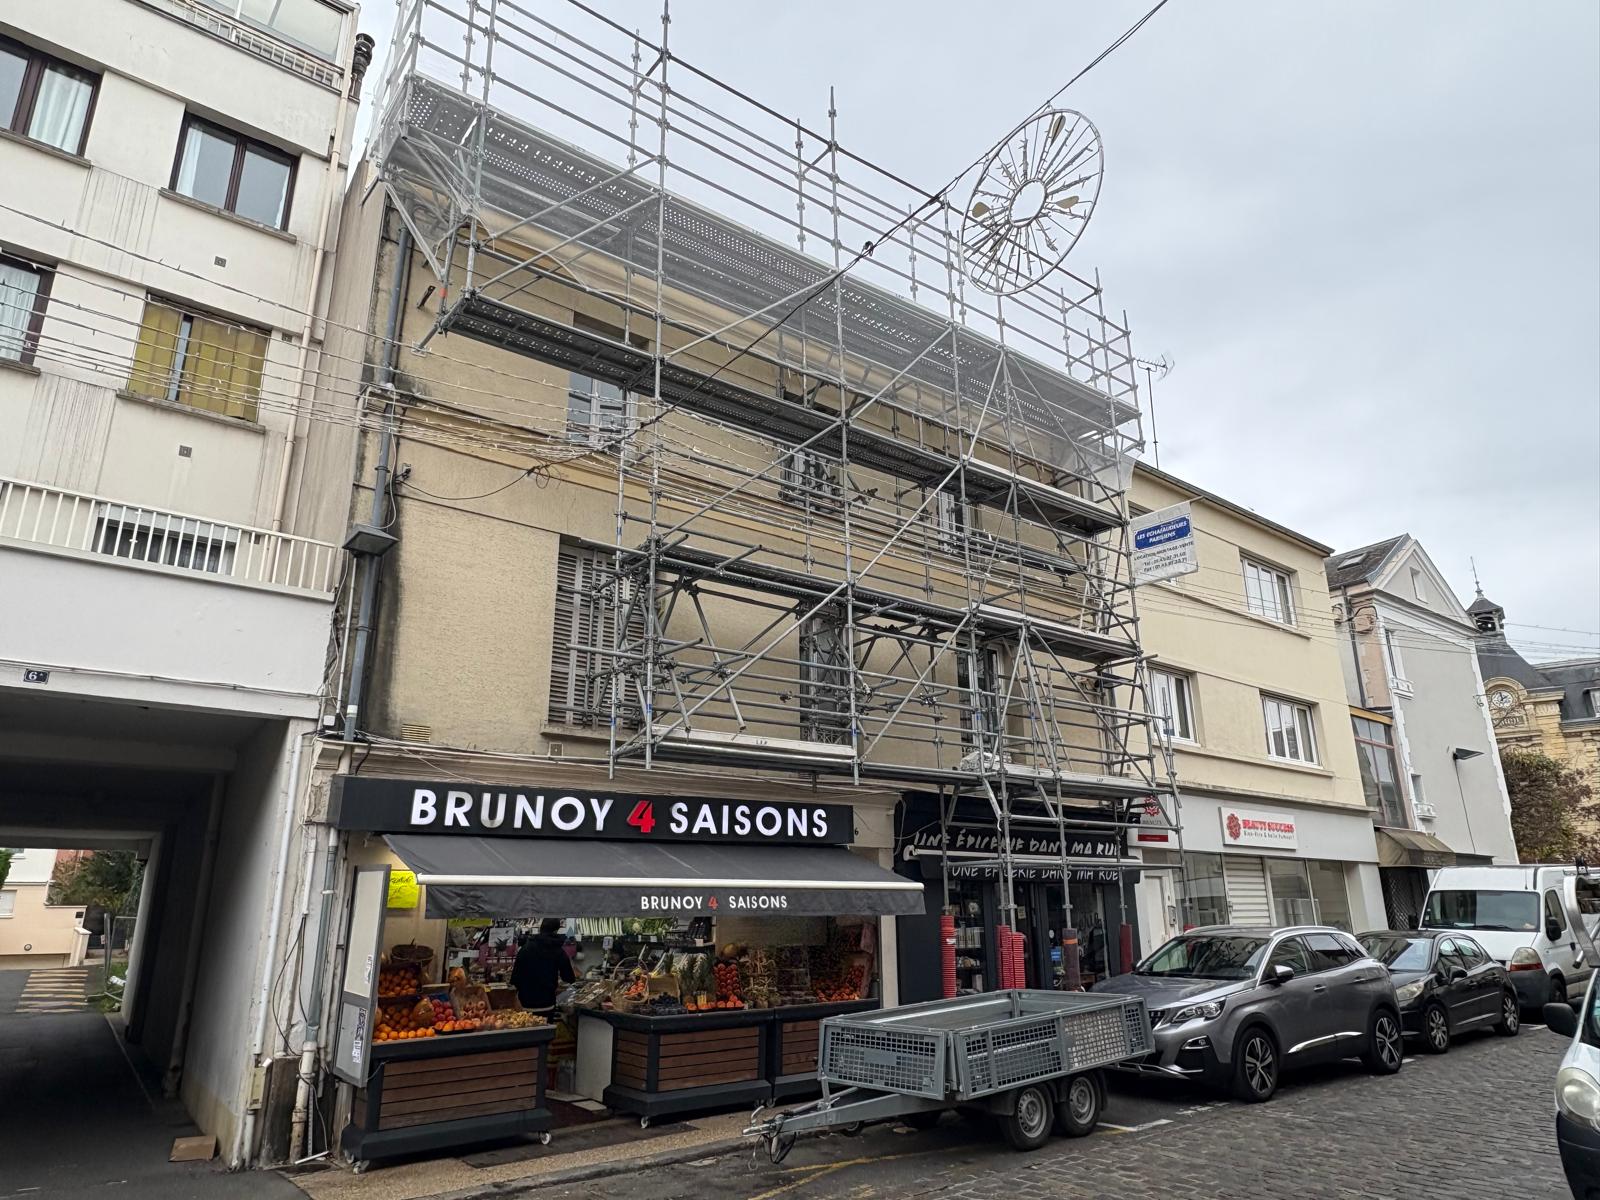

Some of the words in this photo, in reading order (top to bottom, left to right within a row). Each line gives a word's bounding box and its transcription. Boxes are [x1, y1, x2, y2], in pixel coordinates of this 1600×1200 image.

[410, 788, 614, 832] BRUNOY
[626, 800, 656, 833] 4
[669, 802, 828, 838] SAISONS
[1071, 841, 1092, 855] MA
[952, 866, 979, 877] UNE
[1076, 869, 1094, 880] MA
[1098, 870, 1119, 881] RUE
[641, 896, 703, 910] BRUNOY
[707, 896, 719, 910] 4
[729, 895, 788, 909] SAISONS
